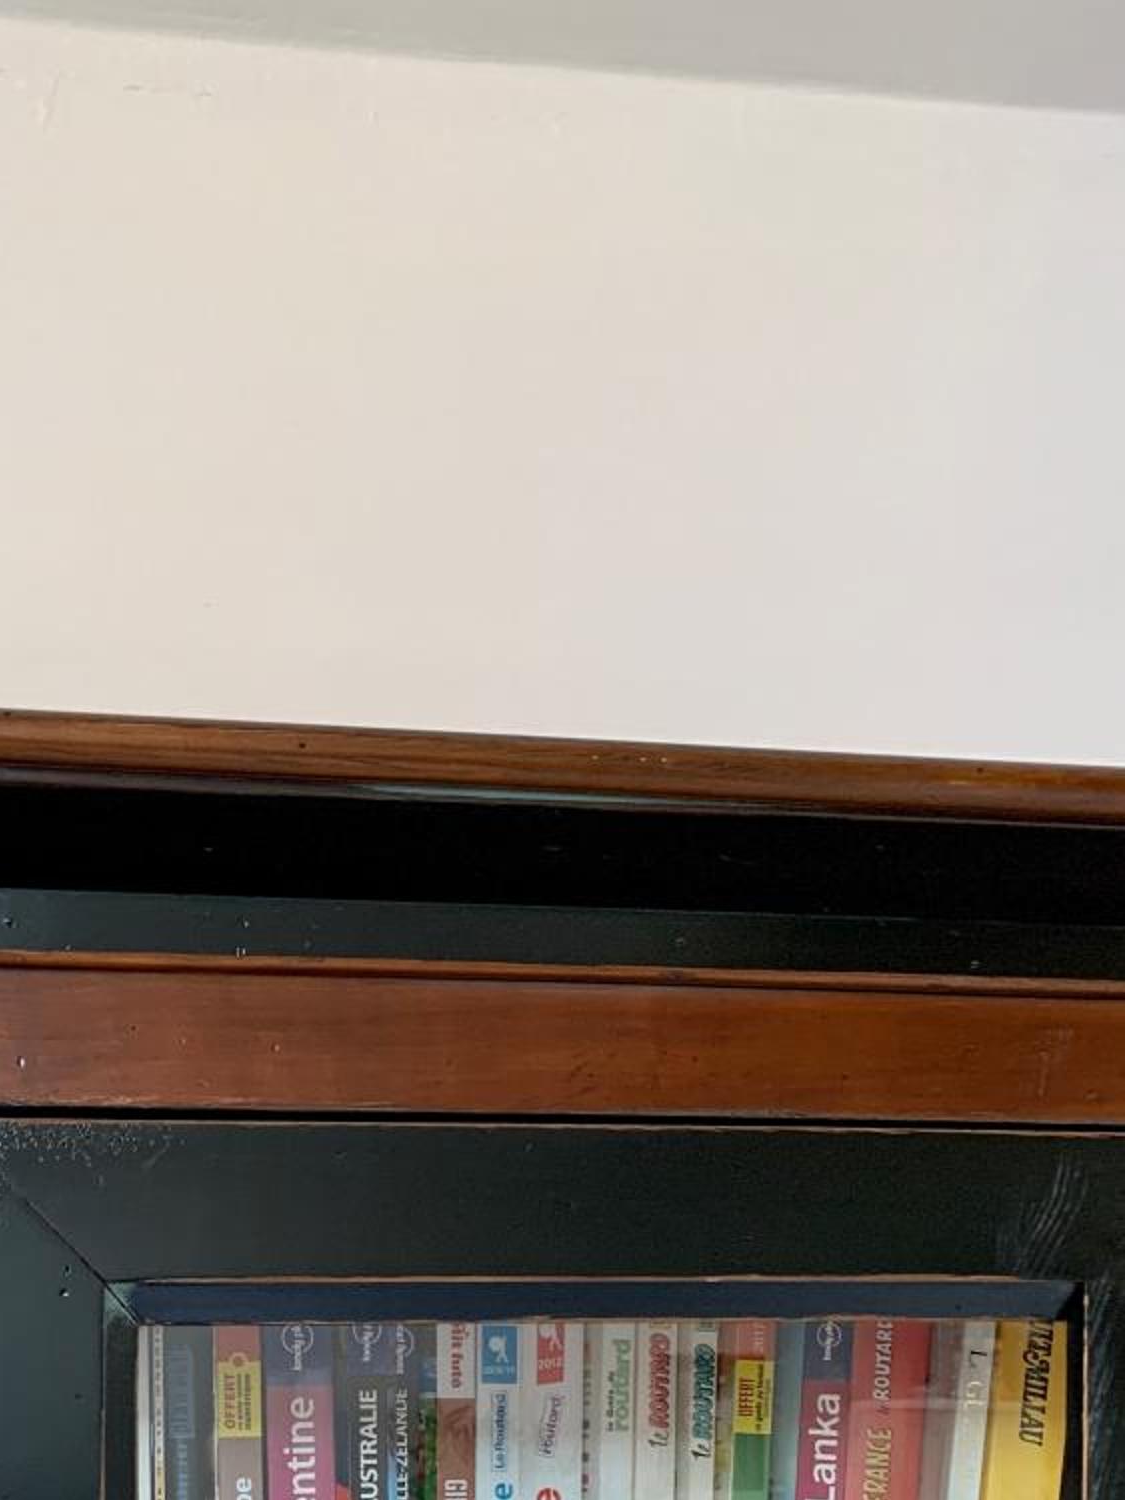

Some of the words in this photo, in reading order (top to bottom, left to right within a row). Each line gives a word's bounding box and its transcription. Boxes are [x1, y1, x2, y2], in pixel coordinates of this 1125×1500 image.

[223, 1374, 236, 1429] OFFERT
[612, 1338, 630, 1432] routard
[648, 1333, 671, 1429] ROUTARD
[692, 1343, 715, 1441] ROUTARD
[738, 1377, 755, 1417] OFFERT
